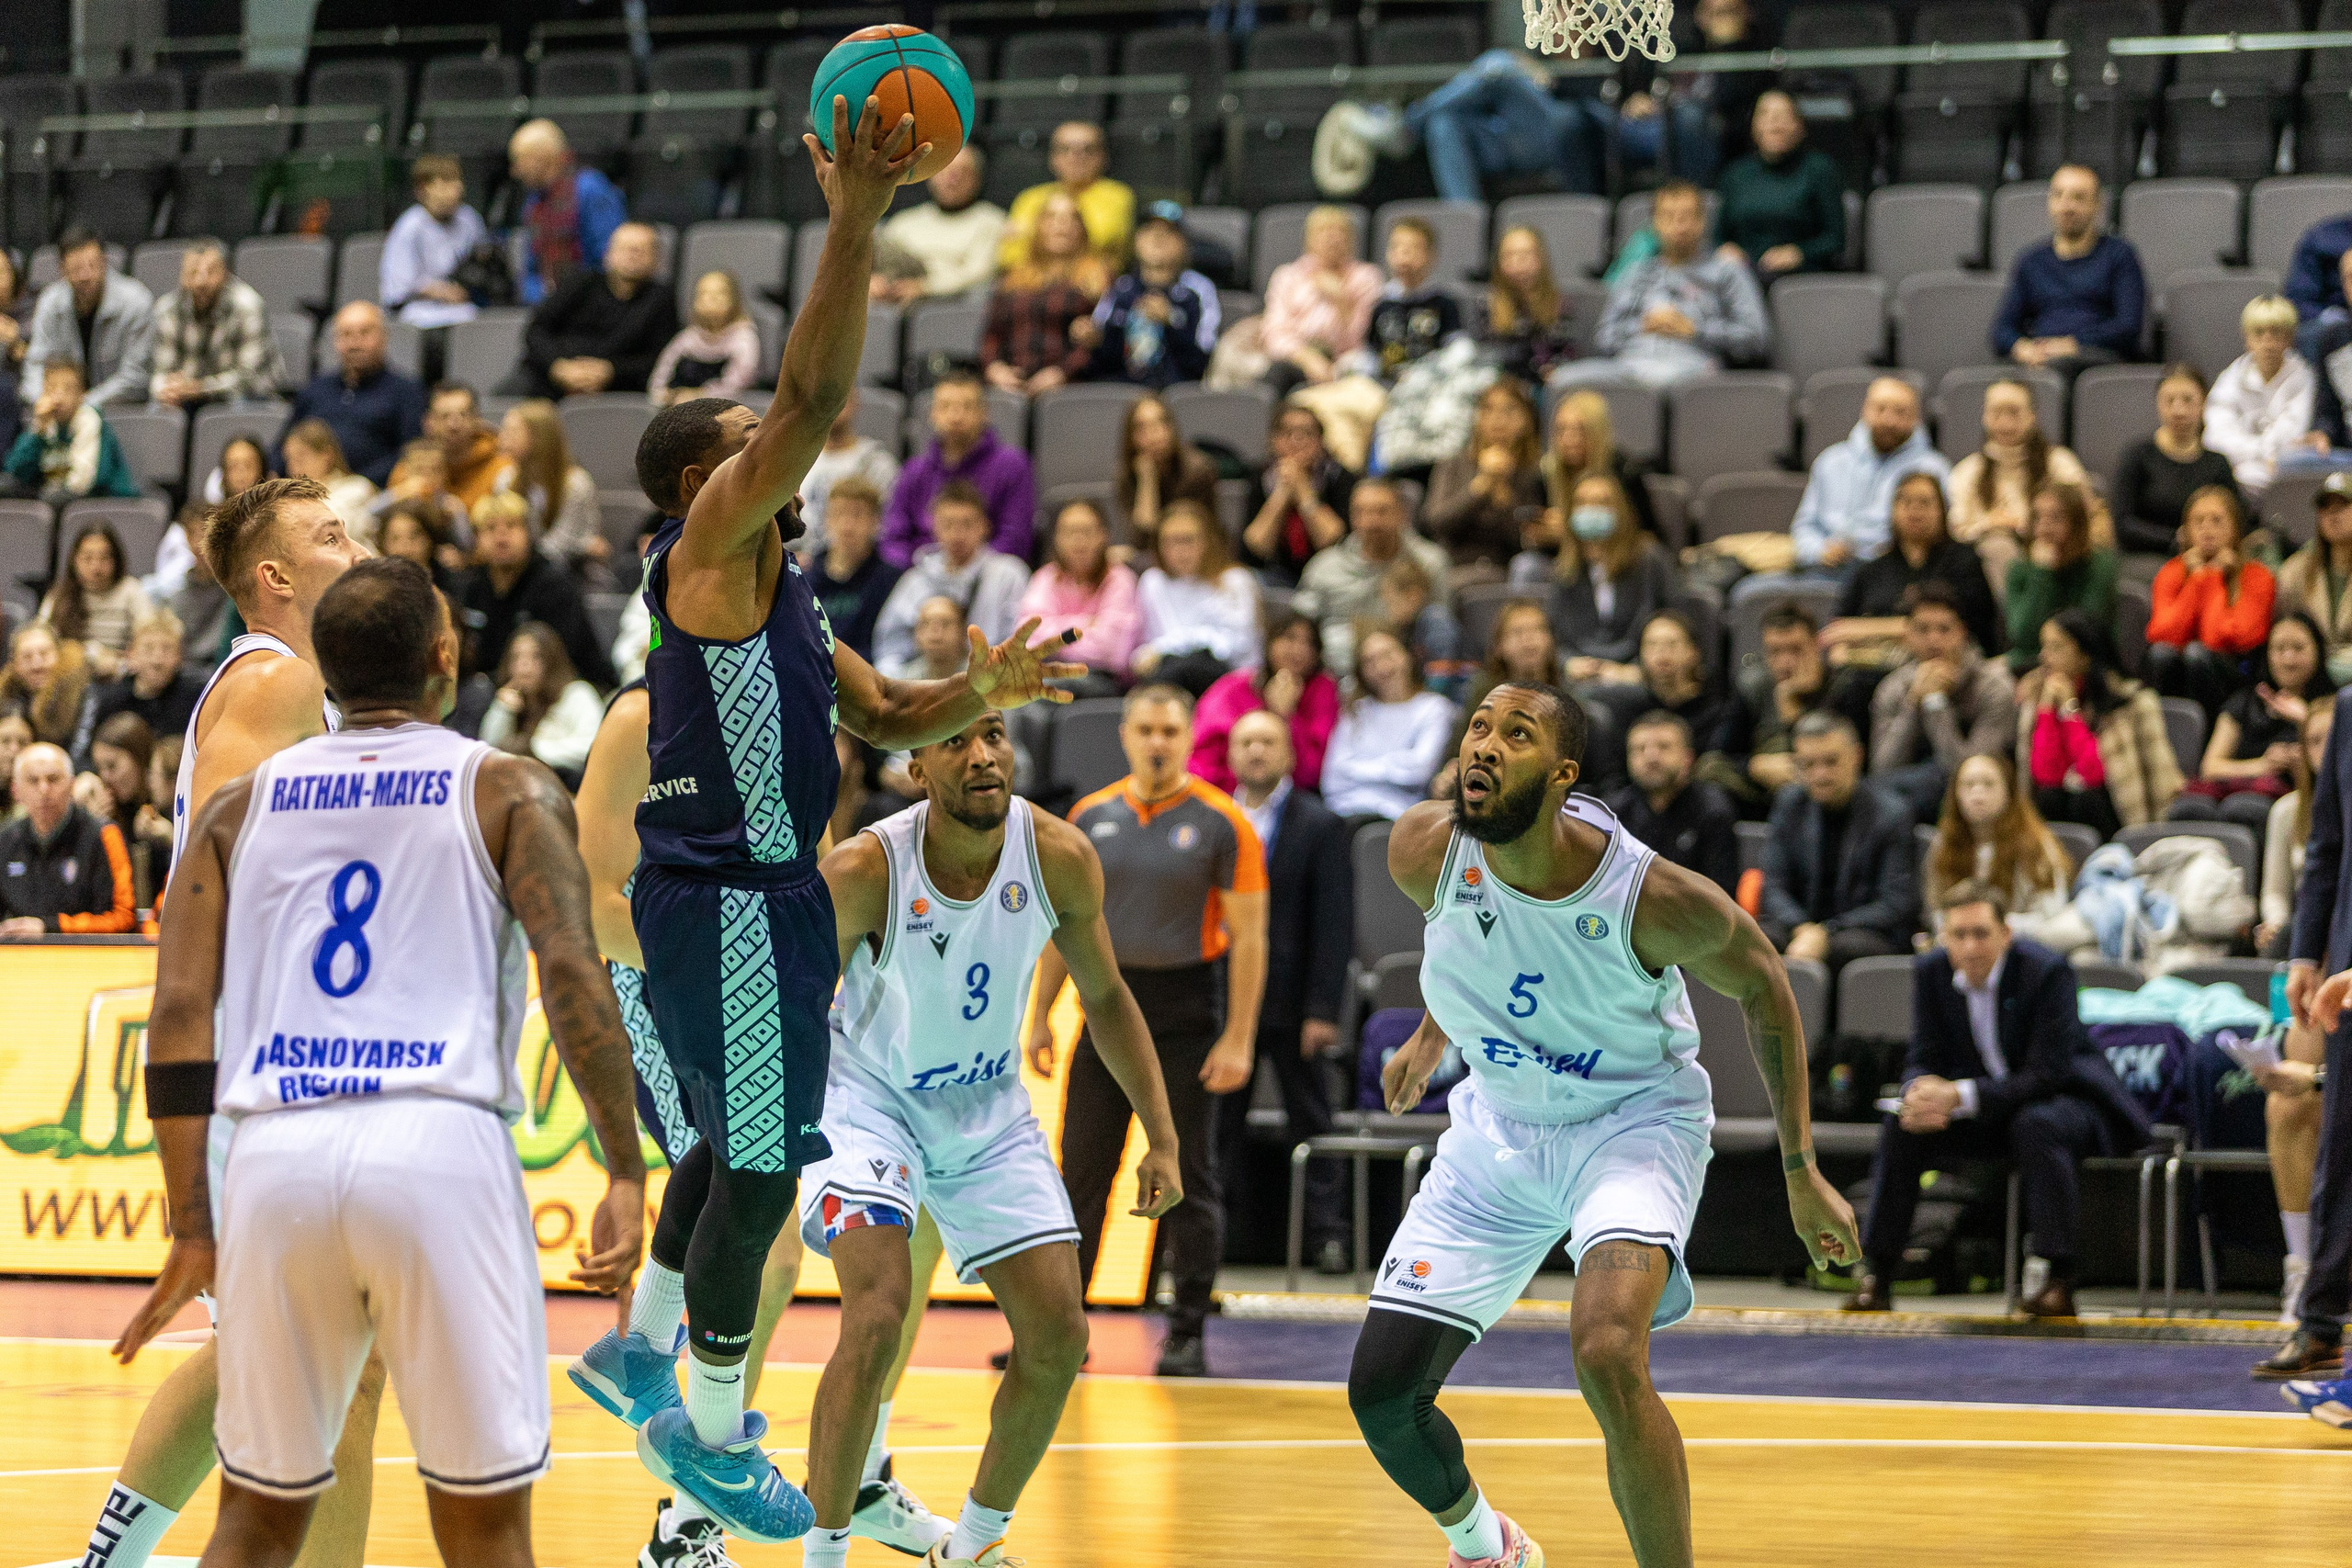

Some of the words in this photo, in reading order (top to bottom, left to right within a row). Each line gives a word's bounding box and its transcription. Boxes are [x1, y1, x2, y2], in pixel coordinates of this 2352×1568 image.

[270, 770, 453, 813] RATHAN-MAYES
[1455, 891, 1484, 902] ENISEY
[312, 859, 382, 998] 8
[906, 921, 933, 931] ENISEY
[961, 961, 991, 1021] 3
[1506, 971, 1545, 1020] 5
[252, 1032, 447, 1076] ASNOYARSK
[1396, 1279, 1429, 1292] ENISEY
